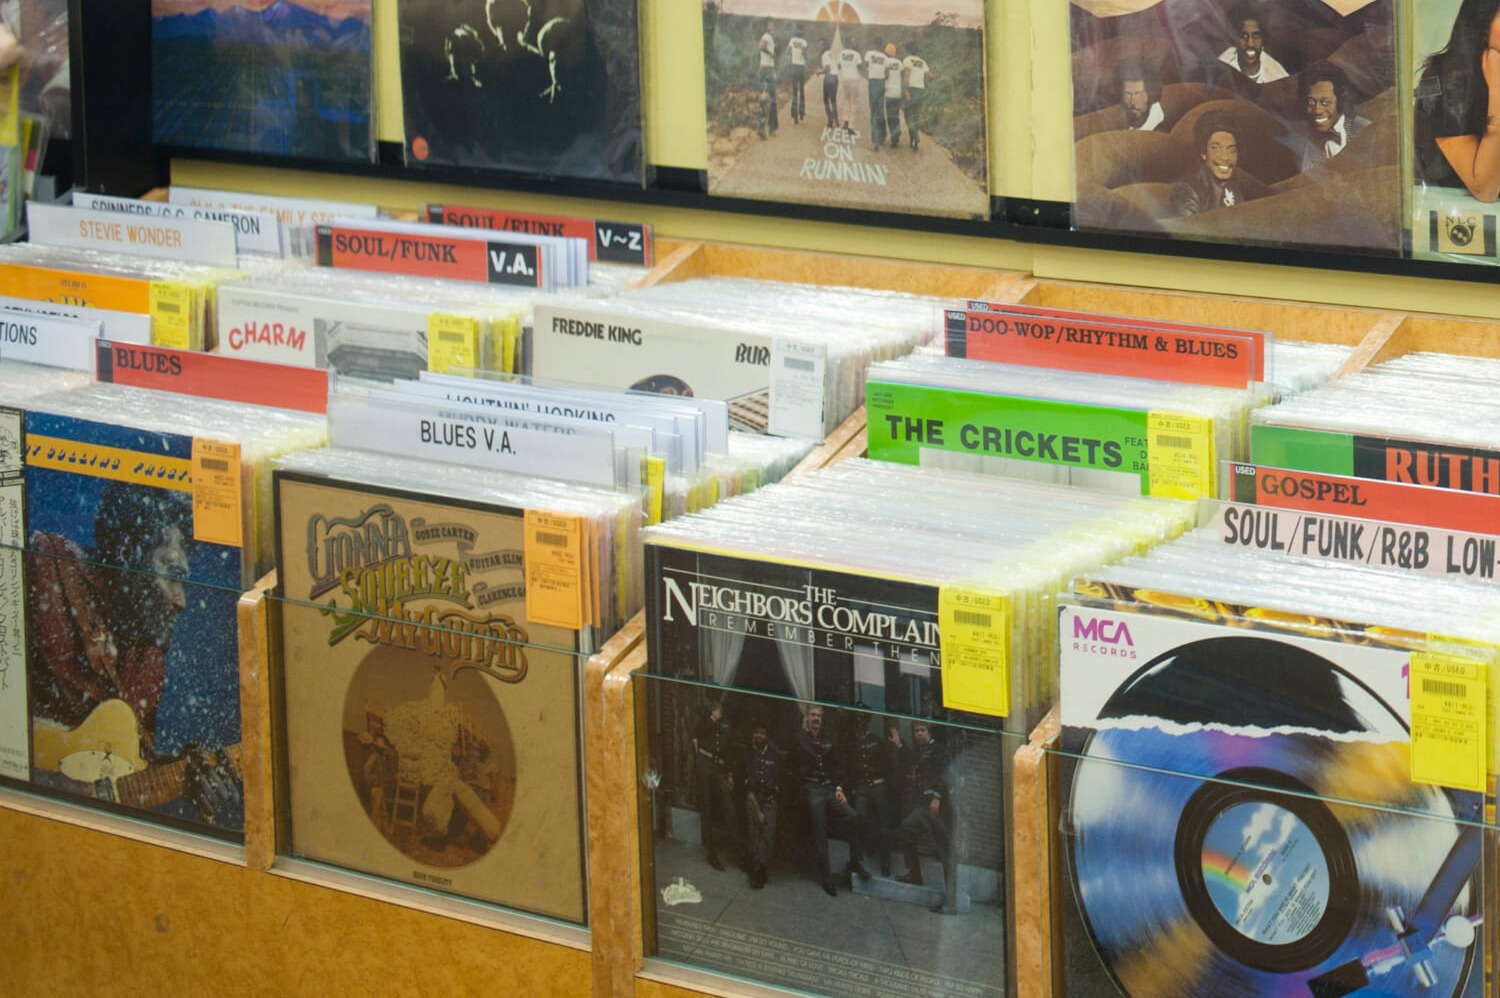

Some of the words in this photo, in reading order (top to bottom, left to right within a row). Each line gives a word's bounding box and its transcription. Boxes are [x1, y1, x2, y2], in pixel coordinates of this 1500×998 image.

[820, 127, 861, 145] KEEP
[824, 142, 854, 162] ON
[800, 157, 889, 186] RUNNIN'
[79, 219, 123, 241] STEVIE
[126, 223, 182, 249] WONDER
[336, 233, 458, 265] SOUL/FUNK
[490, 250, 534, 277] V.A.
[552, 317, 605, 340] FREDDIE
[608, 325, 643, 346] KING
[948, 311, 967, 321] USED
[228, 321, 307, 352] CHARM
[969, 317, 1149, 351] DOO-WOP/RHYTHM
[1154, 337, 1169, 352] &
[1175, 338, 1240, 360] BLUES
[115, 347, 183, 376] BLUES
[734, 343, 771, 366] BUR
[420, 419, 477, 449] BLUES
[483, 427, 517, 455] V.A.
[885, 414, 945, 445] THE
[959, 423, 1124, 469] CRICKETS
[1234, 465, 1256, 476] USED
[1384, 447, 1500, 494] RUTH
[1261, 474, 1368, 507] GOSPEL
[442, 526, 476, 542] CARTER
[1223, 506, 1430, 570] SOUL/FUNK/R&B
[307, 503, 414, 600] GONNA
[469, 556, 500, 571] GUITAR
[502, 553, 523, 566] SLIM
[319, 555, 476, 647] SQUEEZE
[662, 576, 813, 627] NEIGHBORS
[803, 584, 838, 607] THE
[420, 605, 529, 684] GUITAR
[708, 614, 854, 651] REMEMBER
[872, 641, 941, 666] THEN
[1073, 615, 1135, 647] MCA
[1073, 642, 1137, 660] RECORDS
